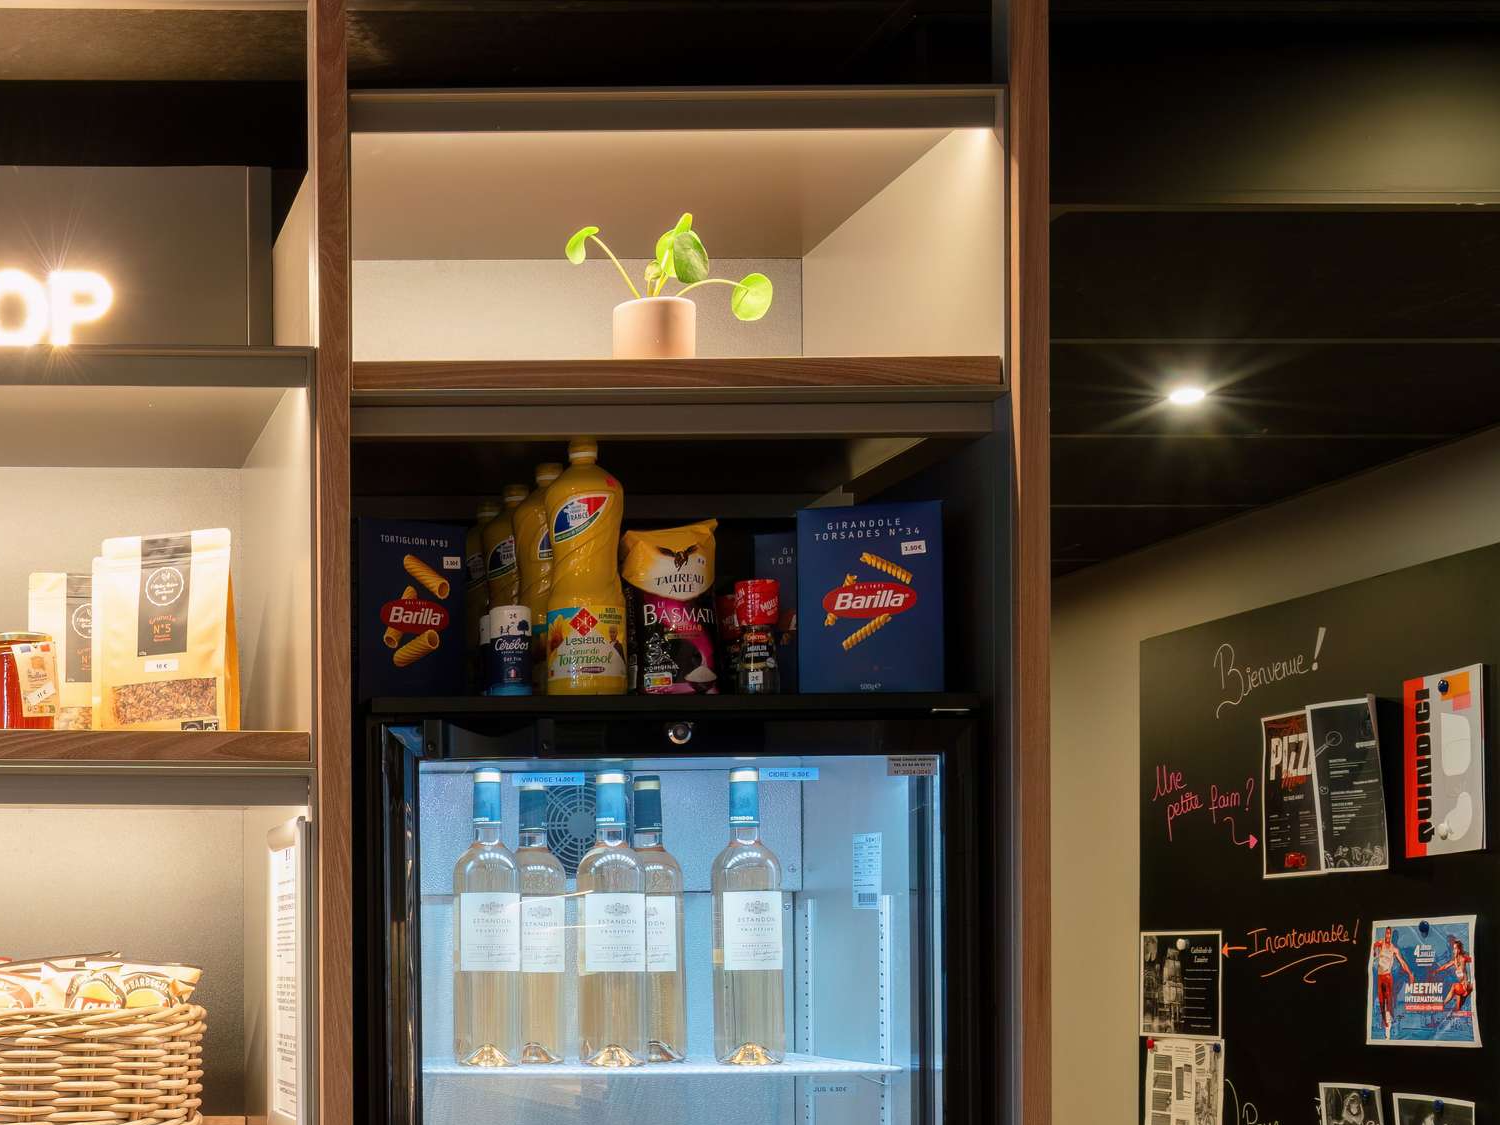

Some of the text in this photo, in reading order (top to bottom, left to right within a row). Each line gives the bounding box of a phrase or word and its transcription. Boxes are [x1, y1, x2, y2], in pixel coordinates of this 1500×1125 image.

[827, 518, 901, 530] GIRANDOLE
[380, 534, 428, 546] TORTIGLIONI
[814, 529, 881, 541] TORSADES
[654, 573, 705, 586] TAUREAU
[834, 590, 906, 611] Barilla
[389, 606, 443, 626] Barilla
[643, 603, 715, 626] BASMATI
[494, 638, 529, 650] Cérébos
[1415, 688, 1434, 844] QUINDICI
[1152, 764, 1188, 801] Une
[1166, 791, 1204, 842] petite
[1414, 945, 1420, 957] 4
[1405, 982, 1443, 994] MEETING
